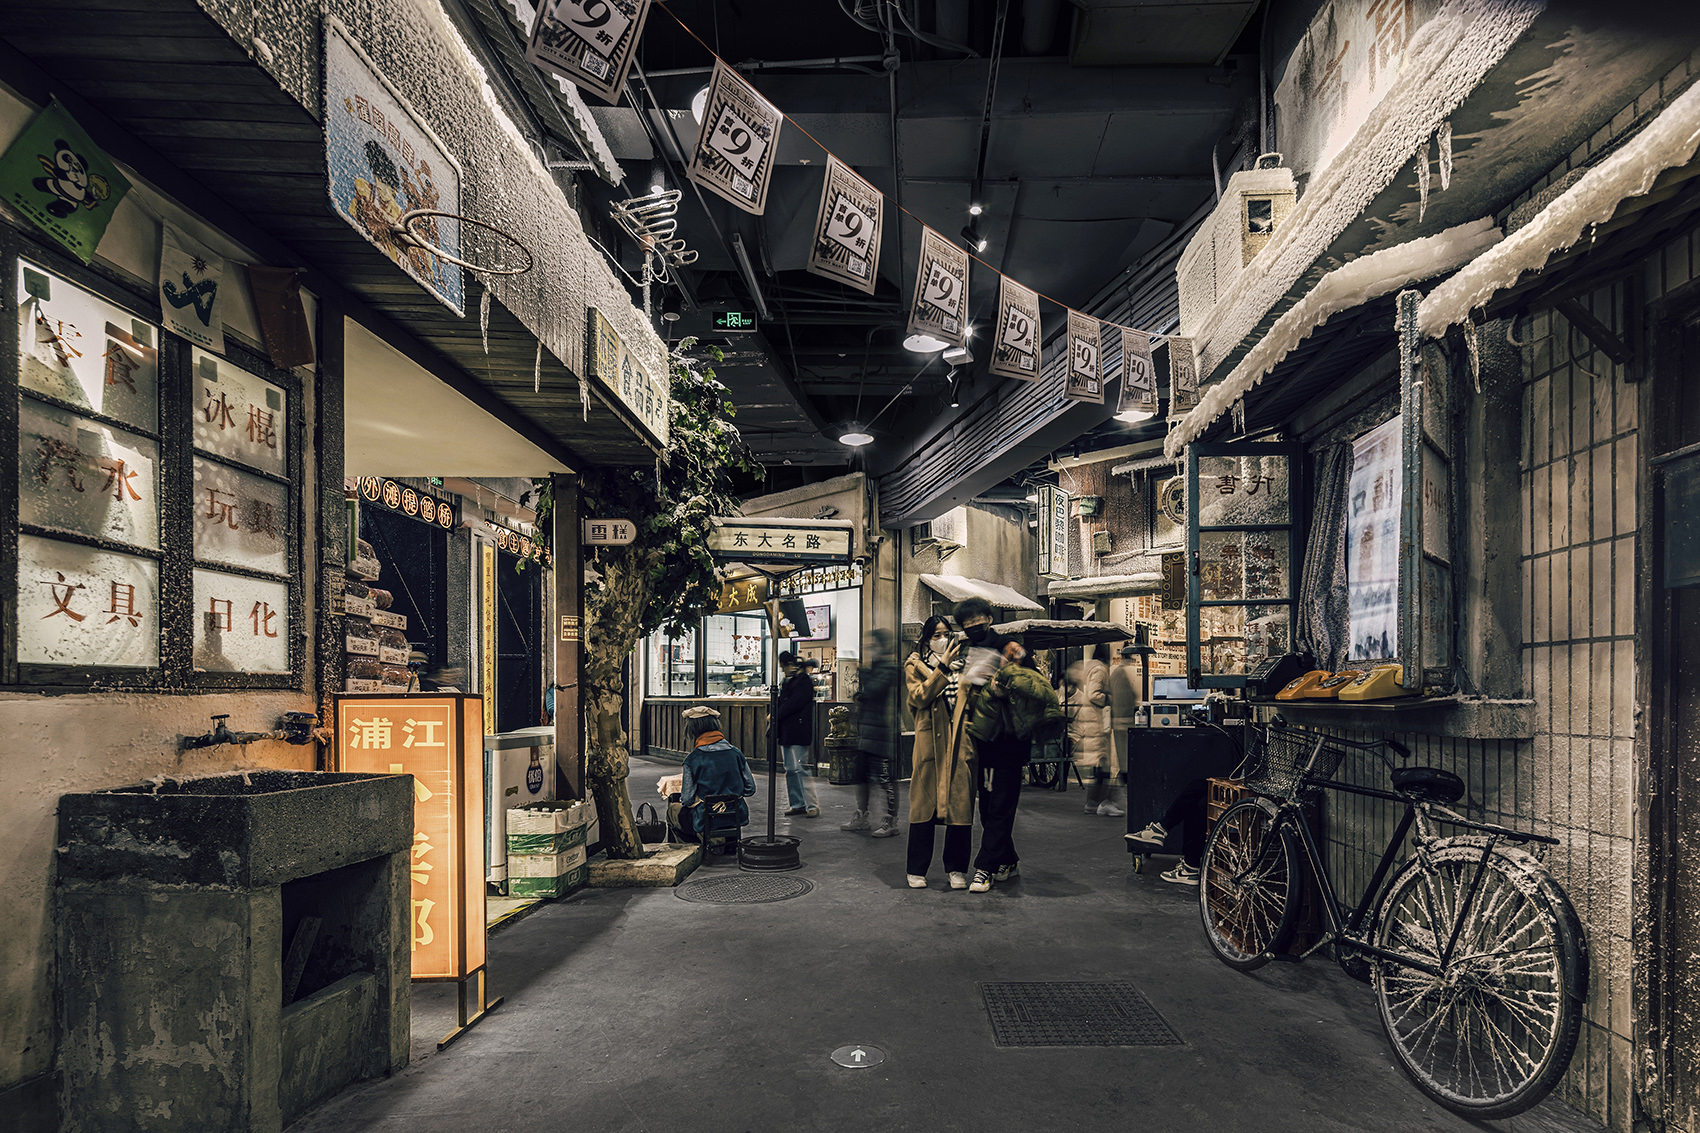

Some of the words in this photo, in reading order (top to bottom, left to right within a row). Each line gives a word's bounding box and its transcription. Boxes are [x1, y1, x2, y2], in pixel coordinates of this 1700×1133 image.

[571, 0, 611, 28] 9
[595, 29, 613, 46] 折
[543, 46, 557, 56] CITY
[559, 53, 576, 65] MART
[722, 128, 751, 155] 9
[740, 156, 755, 171] 折
[838, 212, 863, 238] 9
[855, 237, 866, 249] 折
[933, 276, 954, 301] 9
[948, 298, 957, 309] 折
[1012, 318, 1029, 342] 9
[1080, 347, 1091, 369] 9
[1135, 361, 1145, 383] 9
[204, 386, 277, 450] 冰棍
[35, 435, 142, 502] 汽水
[205, 487, 277, 540] 玩具
[592, 525, 627, 540] 雪糕
[733, 531, 821, 550] 东大名路
[40, 571, 143, 628] 文具
[208, 597, 279, 639] 日化
[349, 717, 445, 749] 浦江
